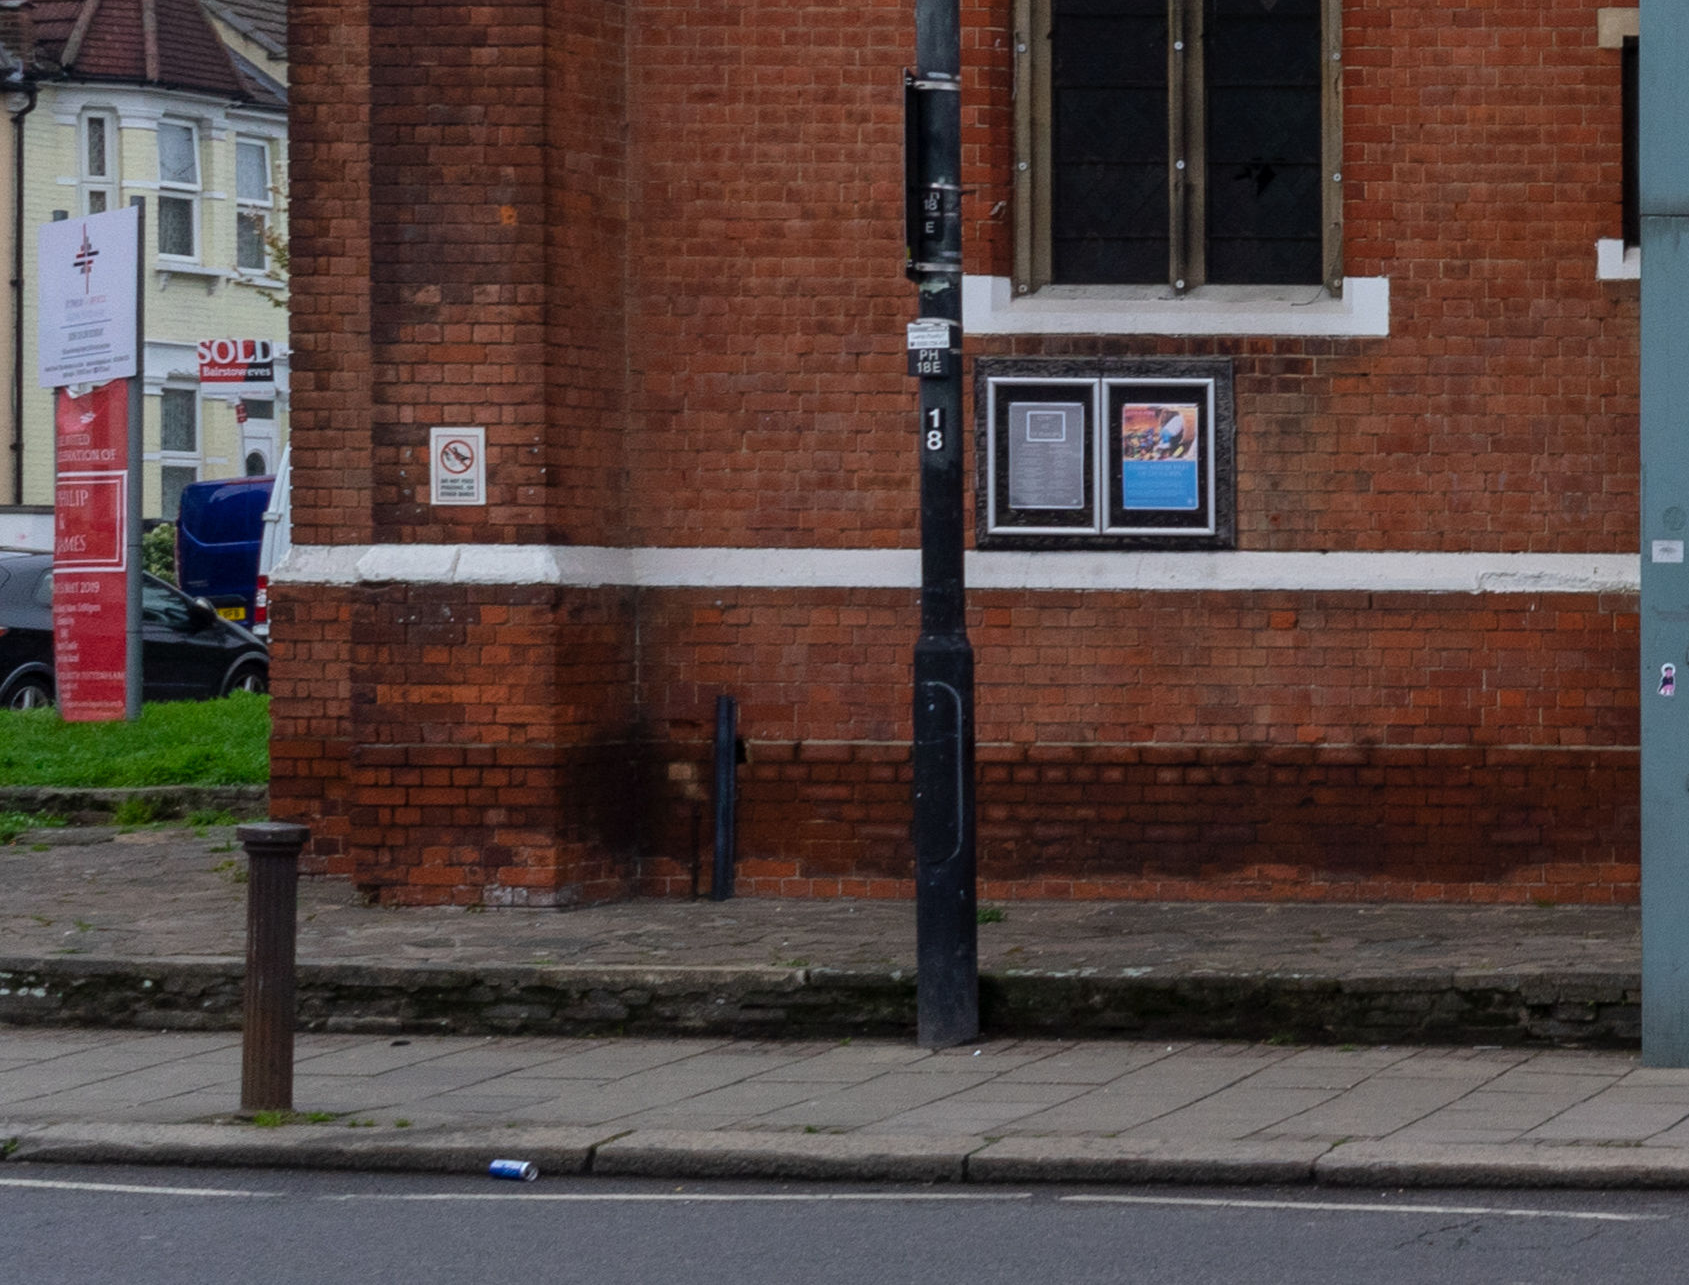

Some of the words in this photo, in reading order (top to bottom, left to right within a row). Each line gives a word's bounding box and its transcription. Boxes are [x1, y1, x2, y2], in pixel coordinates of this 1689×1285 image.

[926, 221, 935, 233] E
[198, 339, 272, 365] SOLD
[920, 350, 938, 361] PH
[917, 361, 941, 373] 18E
